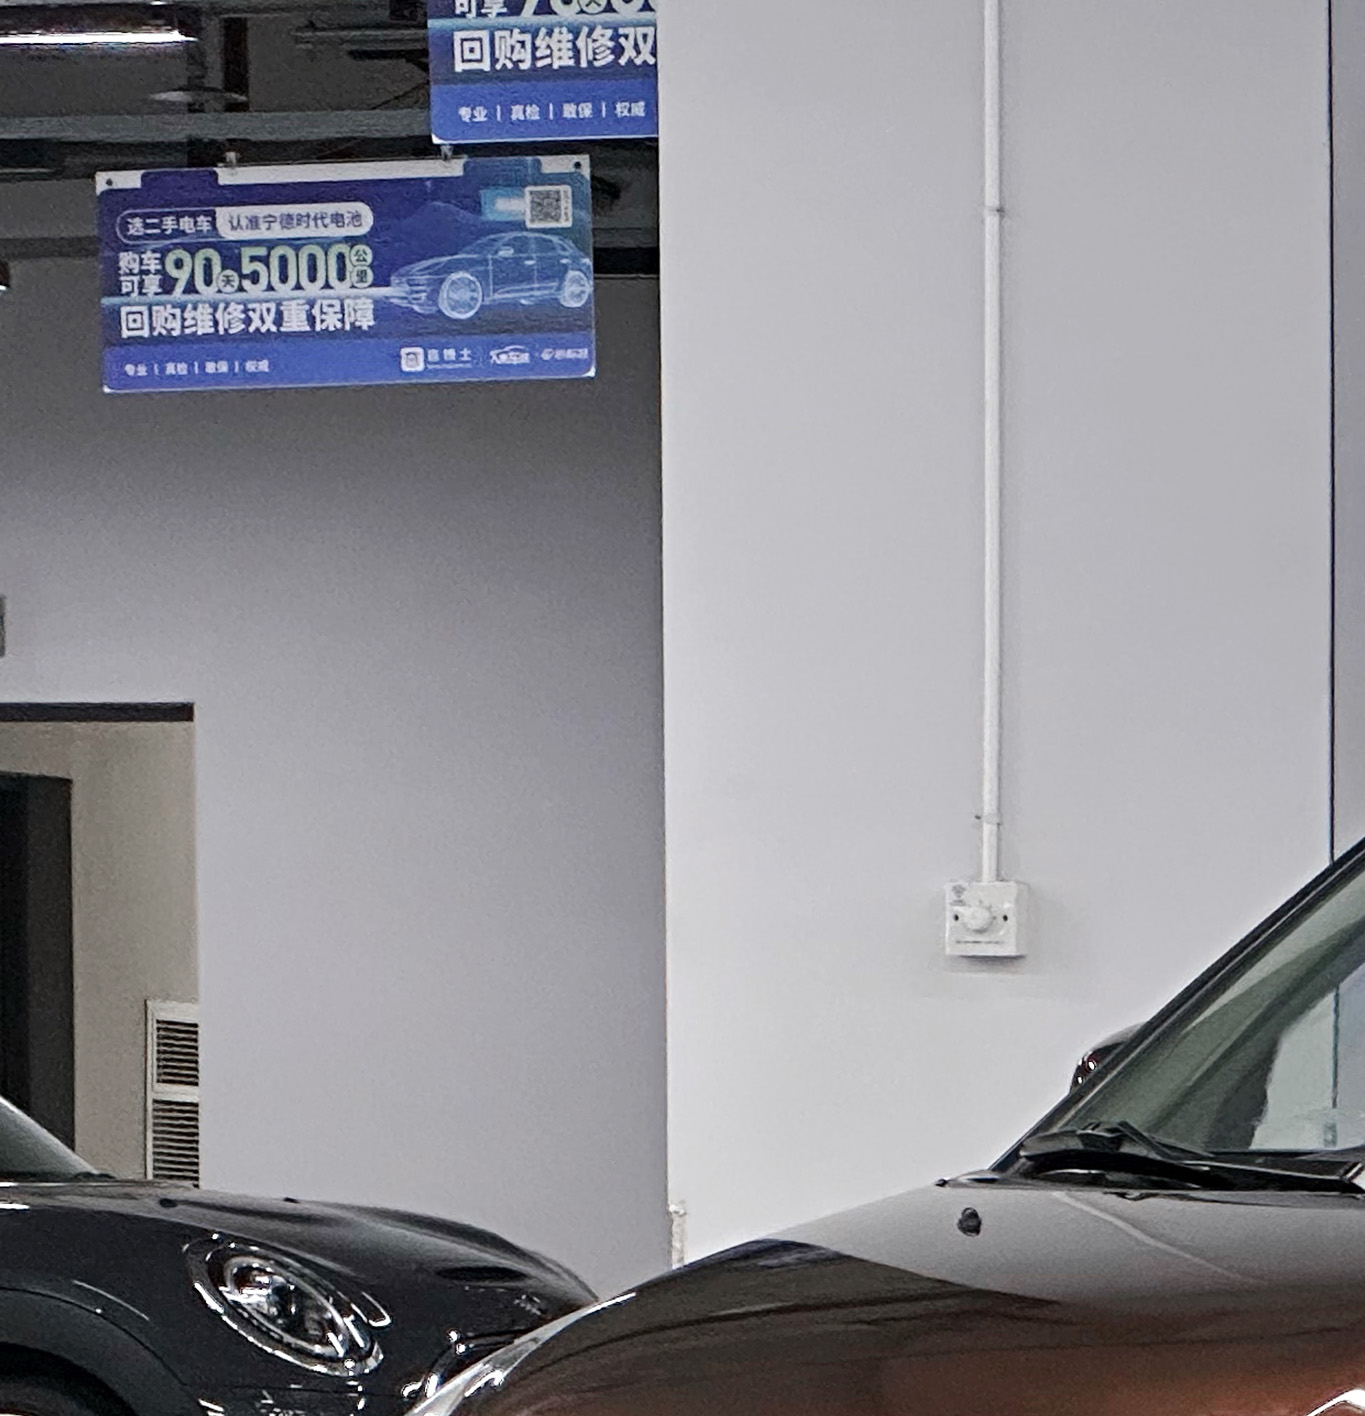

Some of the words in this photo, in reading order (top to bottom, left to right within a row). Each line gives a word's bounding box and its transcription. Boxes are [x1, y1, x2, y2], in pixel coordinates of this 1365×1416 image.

[453, 25, 657, 73] 回购维修双
[127, 215, 213, 236] 选二手电车
[228, 210, 363, 231] 认准宁德时代电池
[118, 250, 162, 274] 购车
[164, 248, 222, 298] 90
[241, 243, 352, 293] 5000
[120, 273, 163, 297] 可享
[120, 298, 376, 338] 回购维修双重保障
